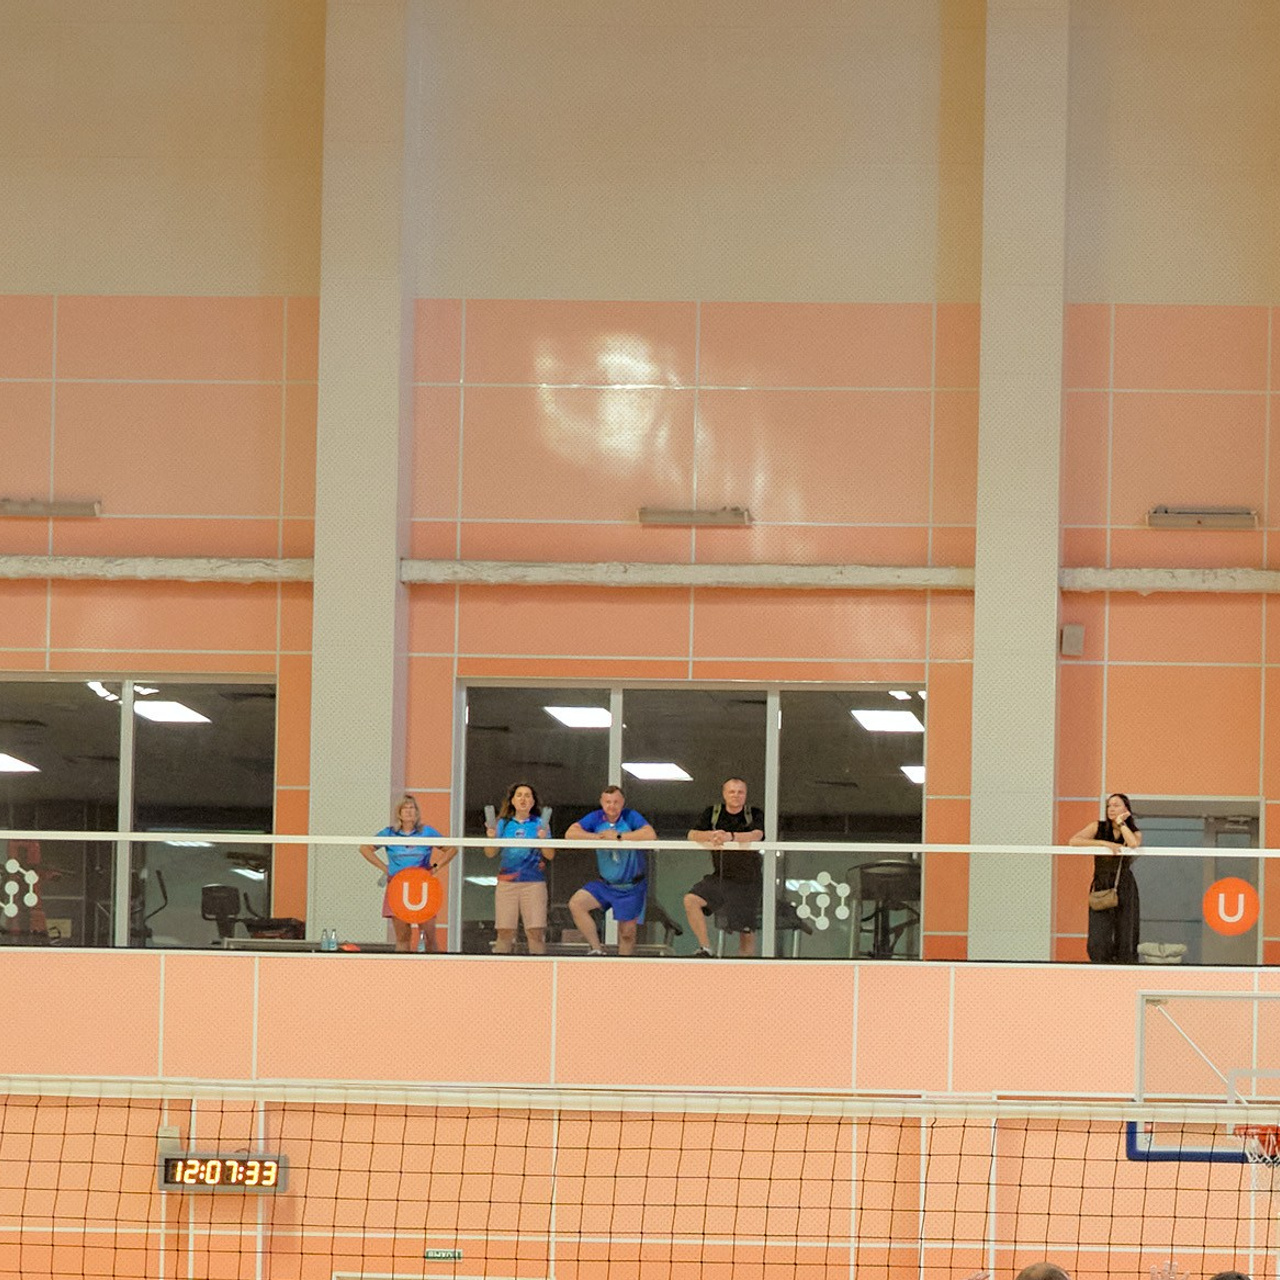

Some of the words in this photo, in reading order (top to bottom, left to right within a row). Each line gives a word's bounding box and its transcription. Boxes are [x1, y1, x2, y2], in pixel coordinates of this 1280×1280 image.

[403, 882, 428, 911] U
[1218, 893, 1245, 923] U
[175, 1159, 278, 1185] 12:07:33
